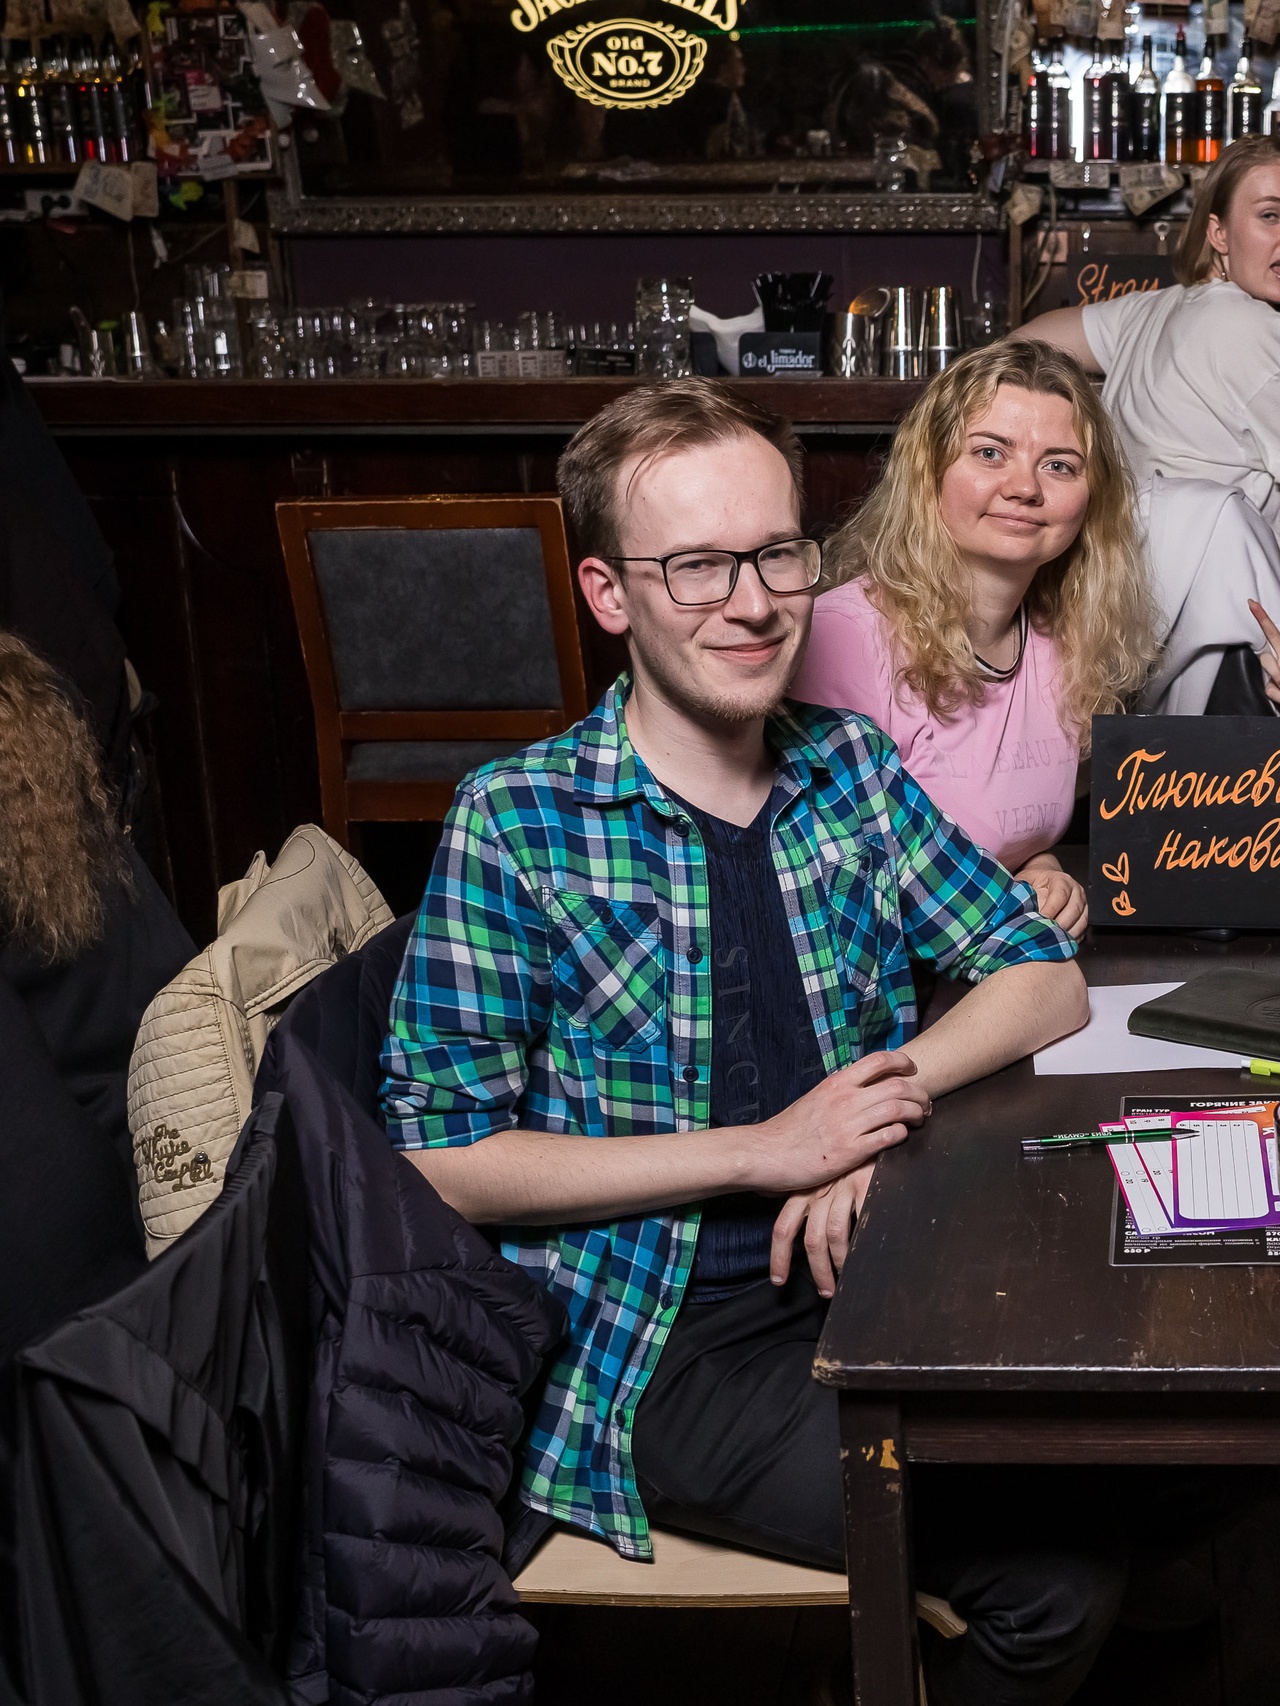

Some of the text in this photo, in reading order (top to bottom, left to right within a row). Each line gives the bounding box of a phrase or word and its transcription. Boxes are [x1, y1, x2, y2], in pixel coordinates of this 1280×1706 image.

[606, 36, 645, 50] Old
[592, 51, 663, 76] No.7
[609, 79, 651, 88] BRAND
[995, 803, 1061, 837] VIENT
